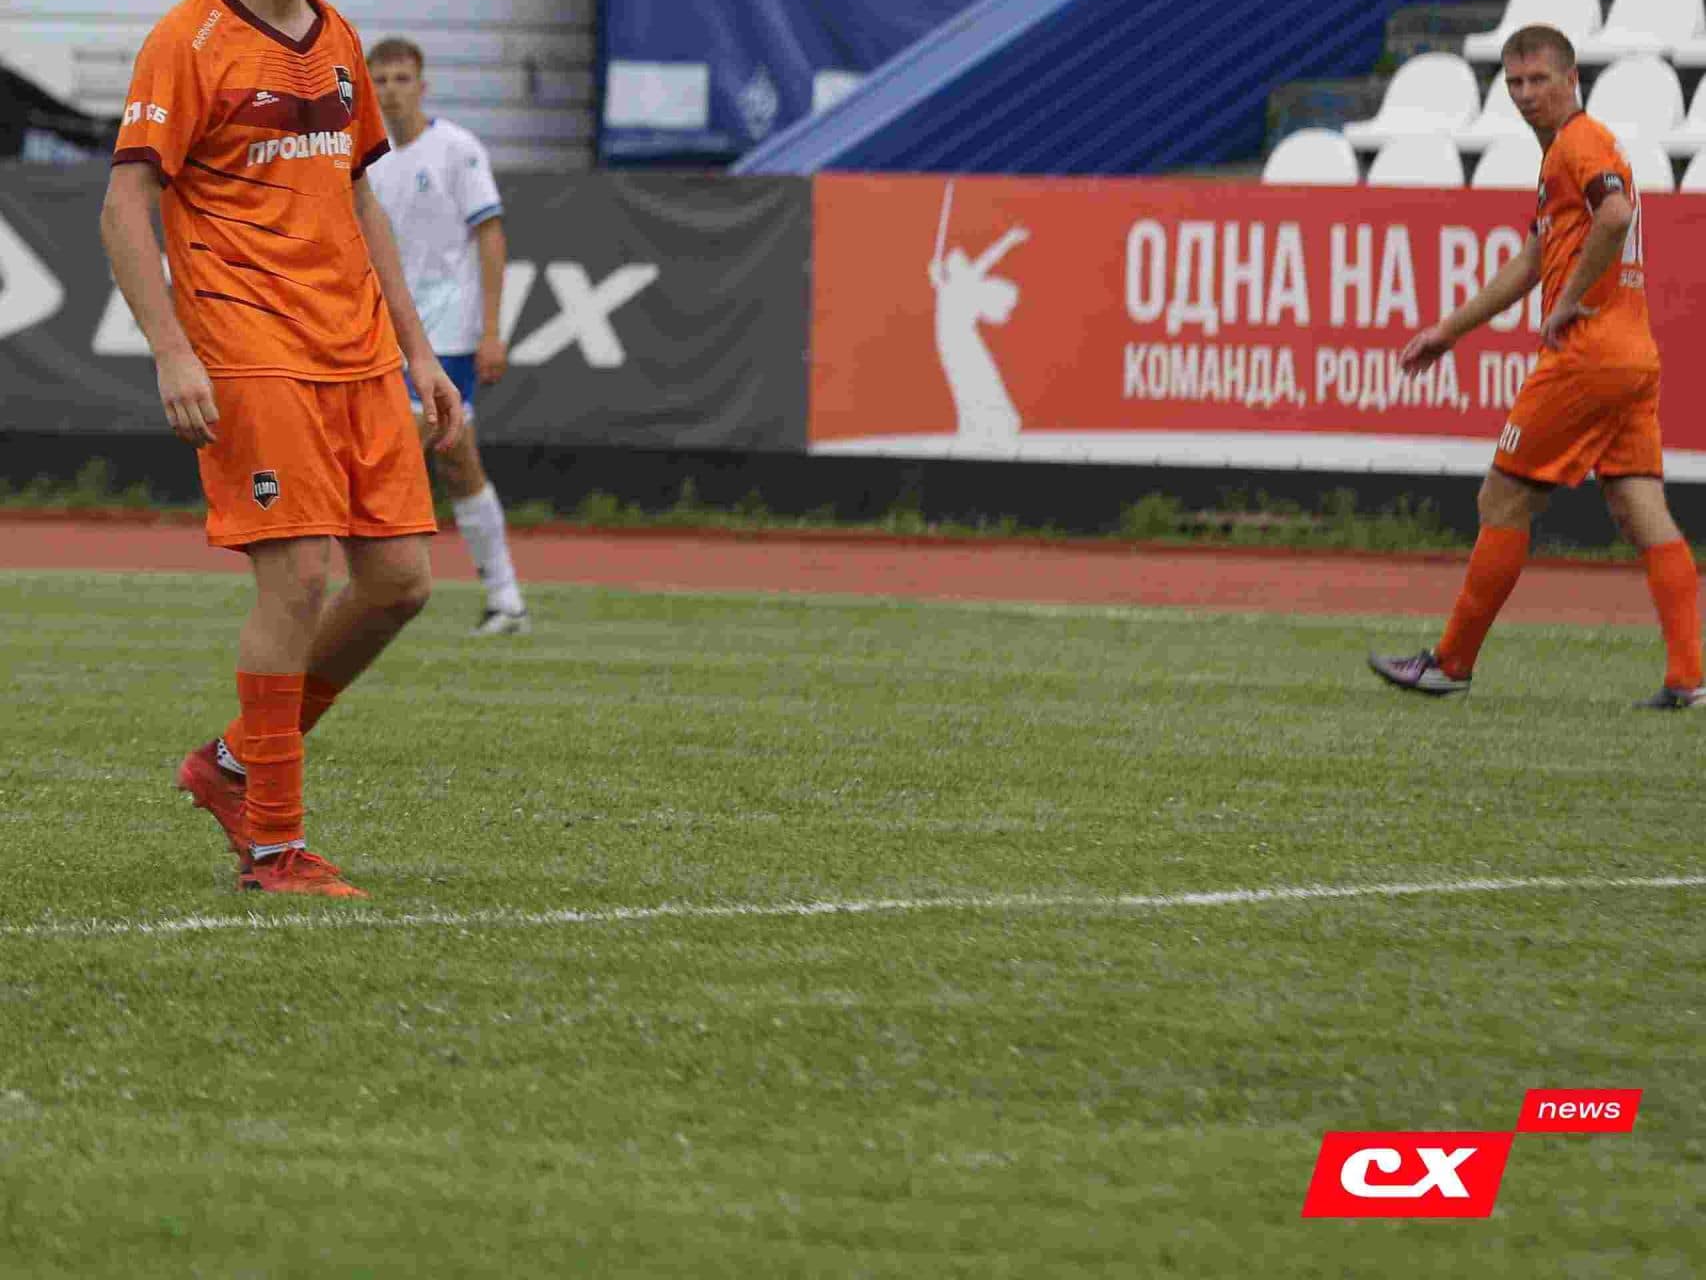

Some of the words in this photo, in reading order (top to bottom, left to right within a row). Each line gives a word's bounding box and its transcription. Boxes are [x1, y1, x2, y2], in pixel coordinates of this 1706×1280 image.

[1125, 219, 1310, 335] ОДНА
[1329, 222, 1419, 328] НА
[1123, 341, 1307, 409] КОМАНДА,
[1315, 345, 1470, 414] РОДИНА,
[1478, 350, 1539, 410] ПО
